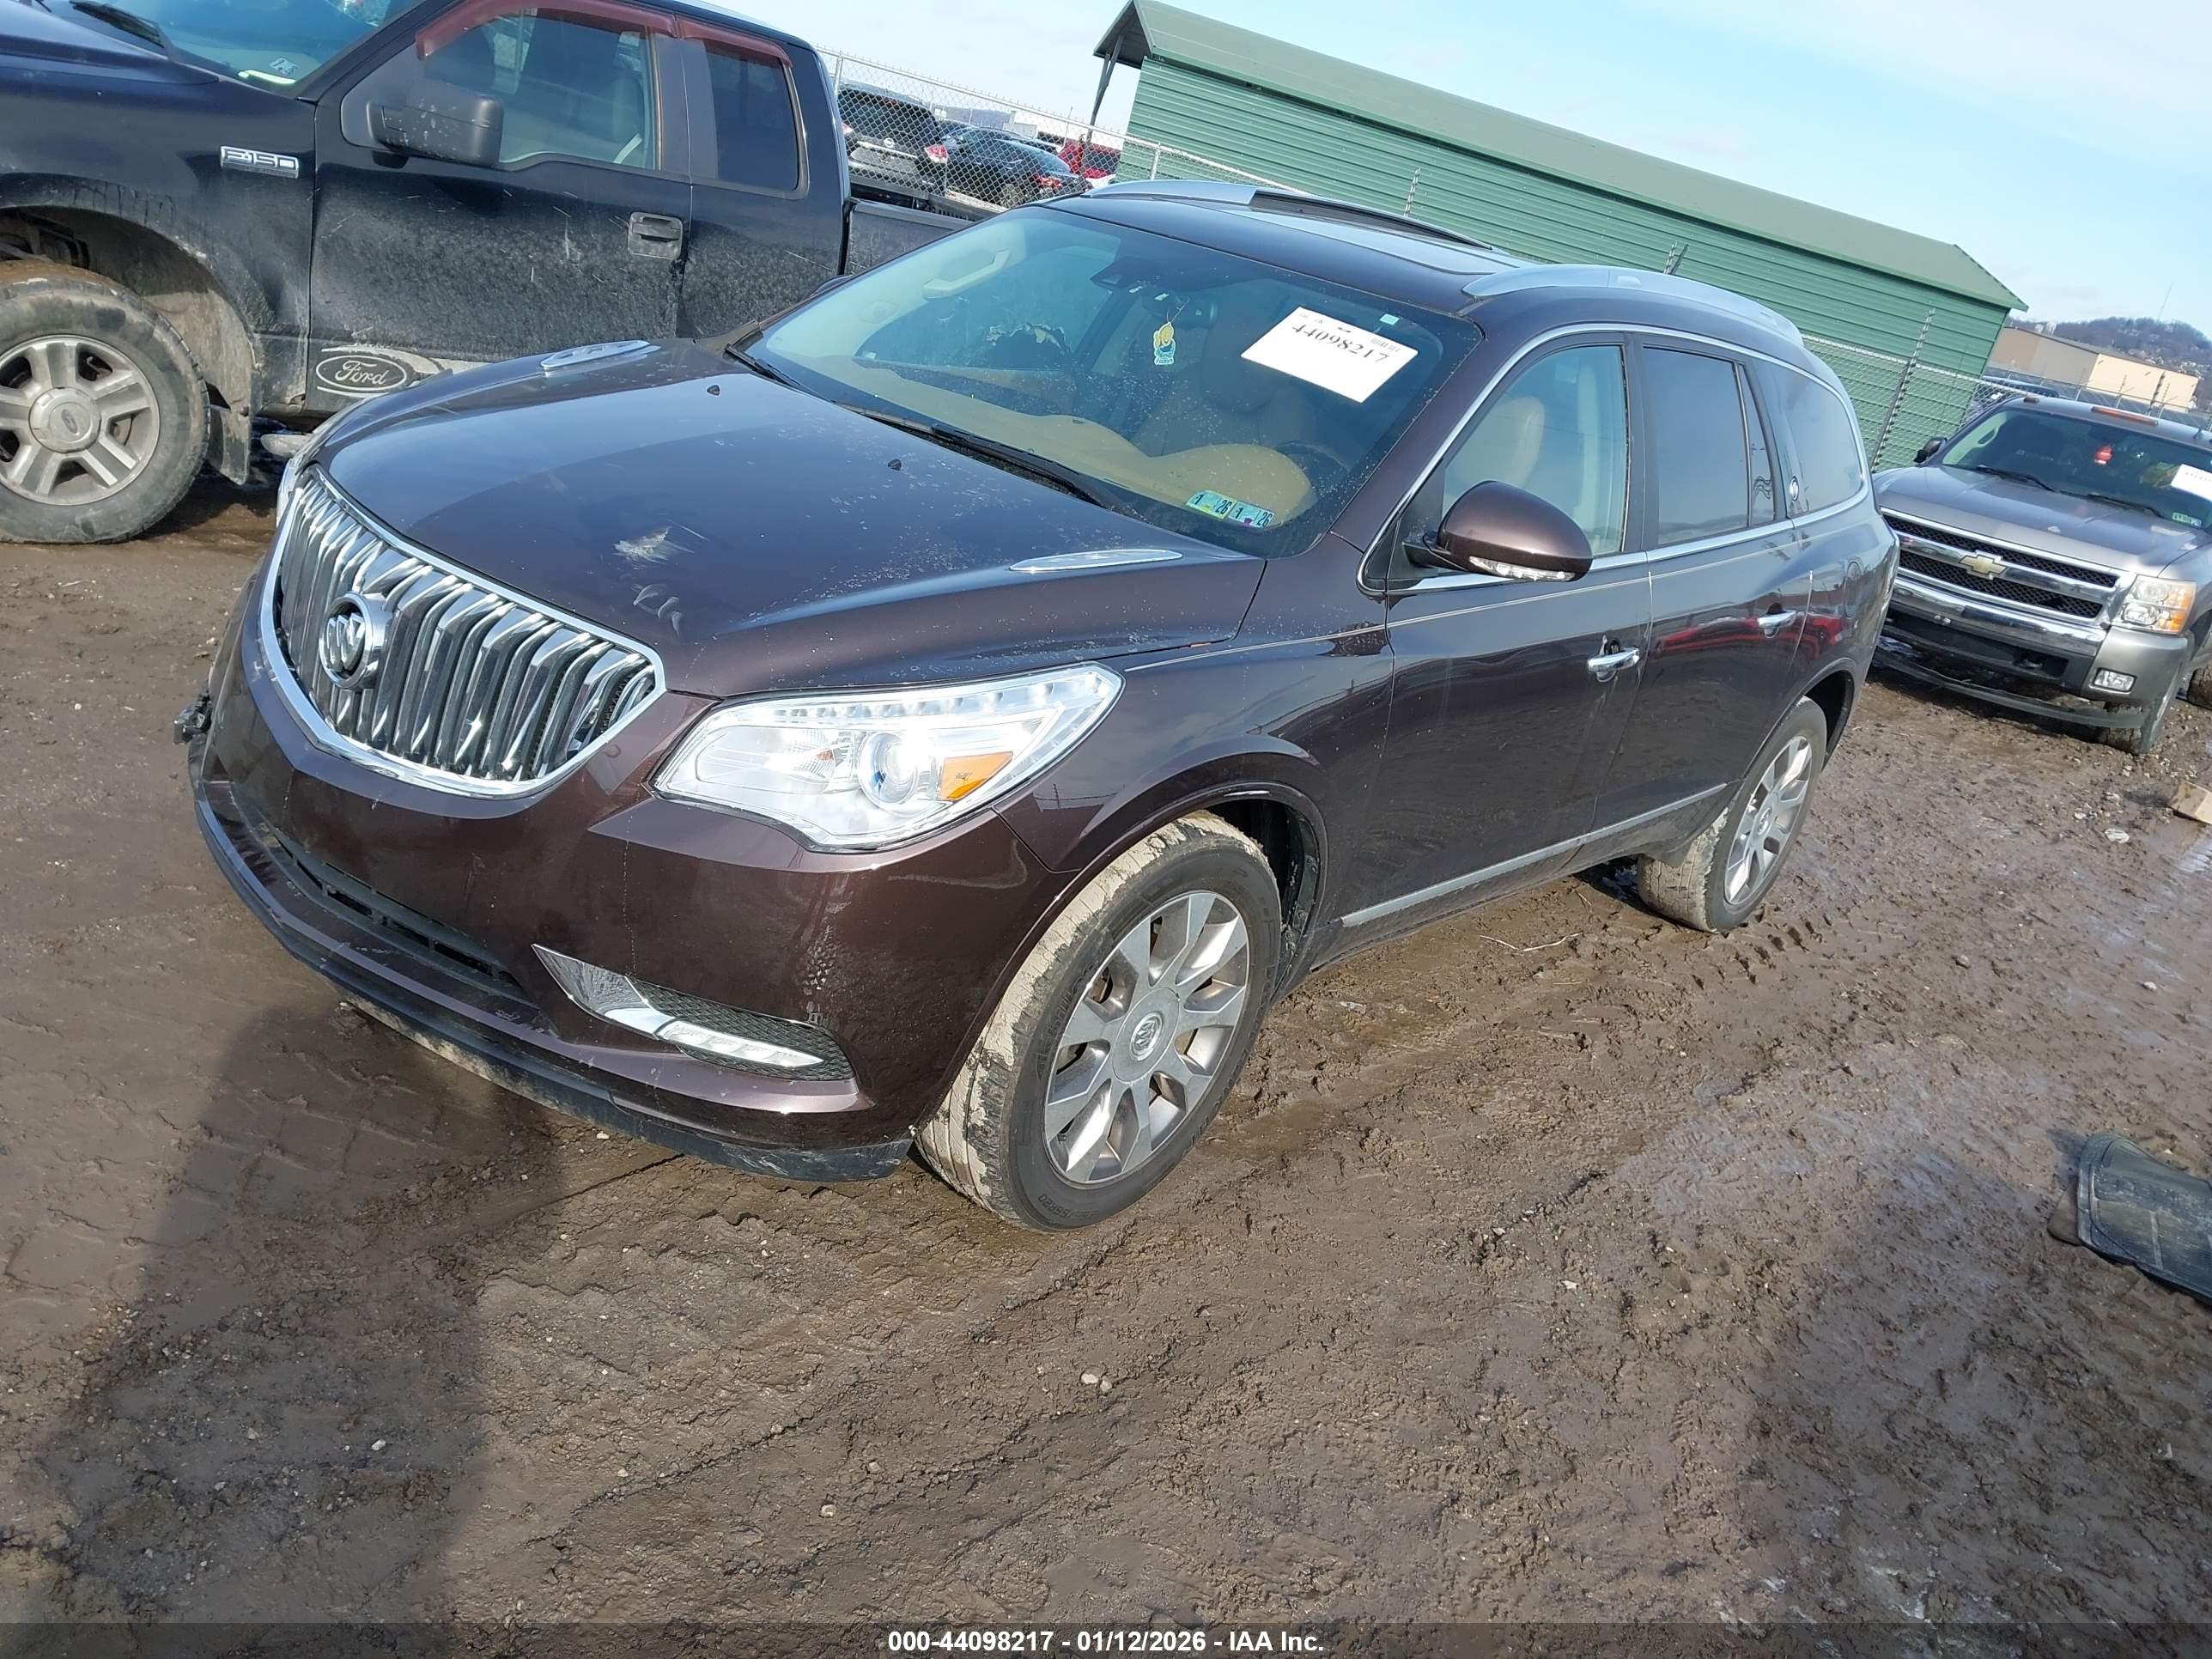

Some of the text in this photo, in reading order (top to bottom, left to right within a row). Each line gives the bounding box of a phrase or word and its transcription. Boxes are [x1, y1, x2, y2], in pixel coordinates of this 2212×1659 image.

[1291, 324, 1390, 362] 44098217
[335, 360, 390, 386] Ford
[1216, 500, 1232, 515] 26
[1257, 512, 1273, 527] 26
